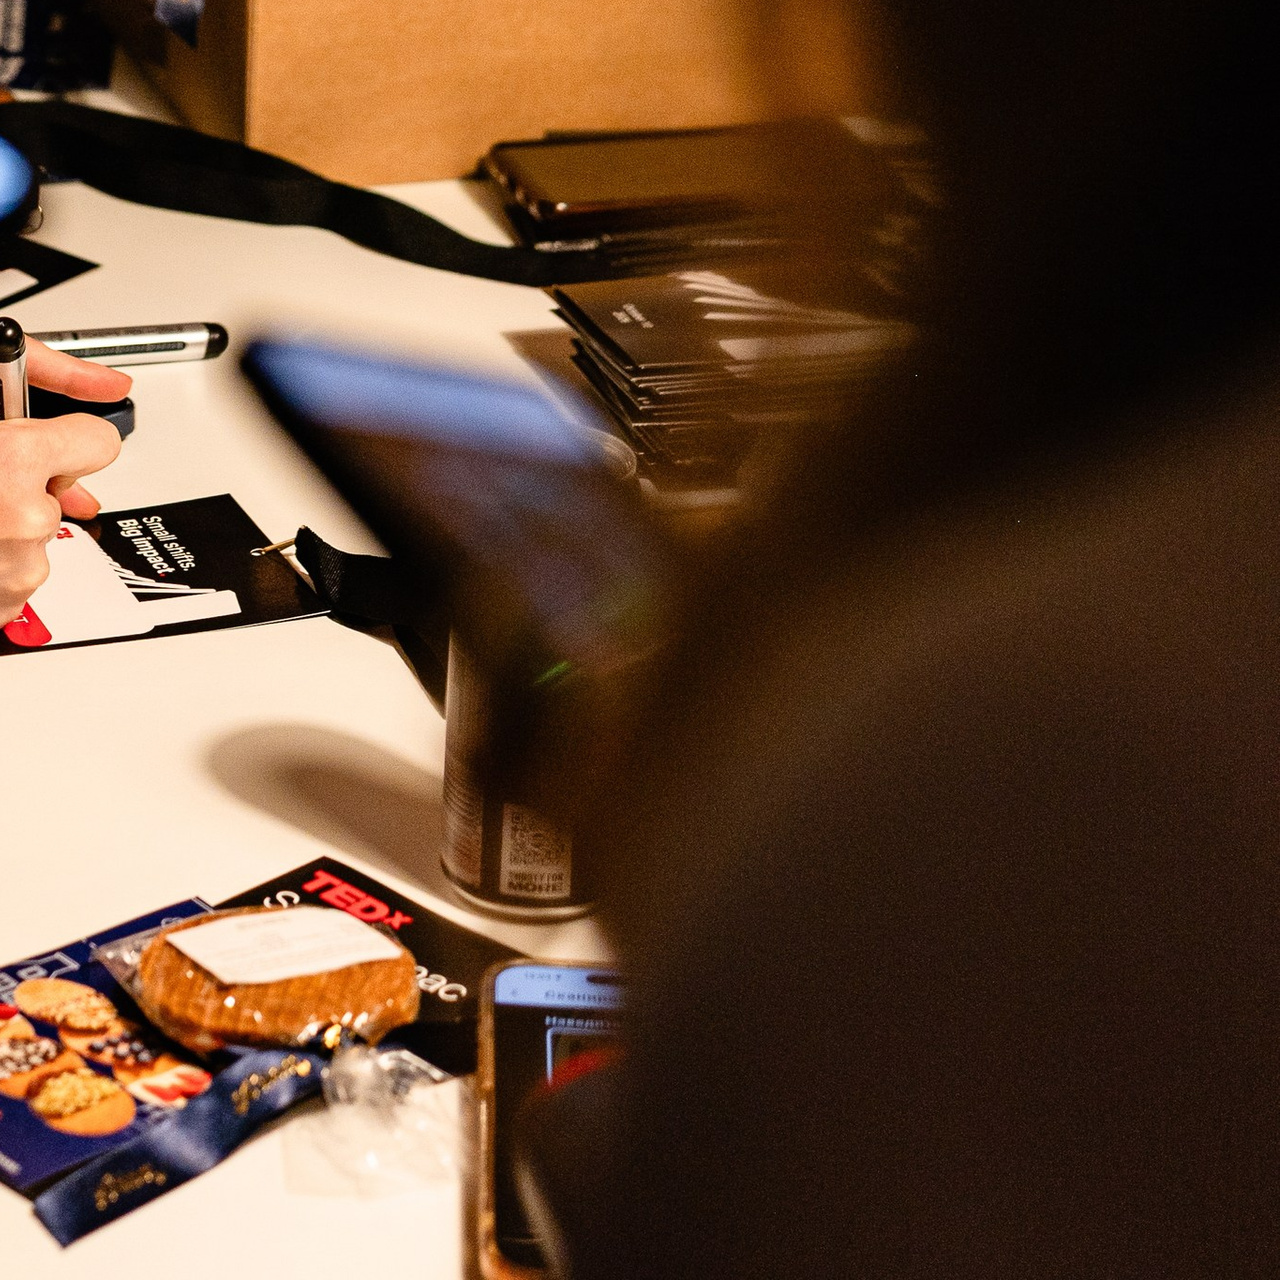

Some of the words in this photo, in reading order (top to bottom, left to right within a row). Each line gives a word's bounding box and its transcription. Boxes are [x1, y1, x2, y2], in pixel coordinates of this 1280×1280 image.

[116, 518, 144, 538] Big
[131, 536, 176, 577] impact.
[142, 515, 178, 542] Small
[163, 542, 196, 572] shifts.
[301, 869, 414, 930] TEDx
